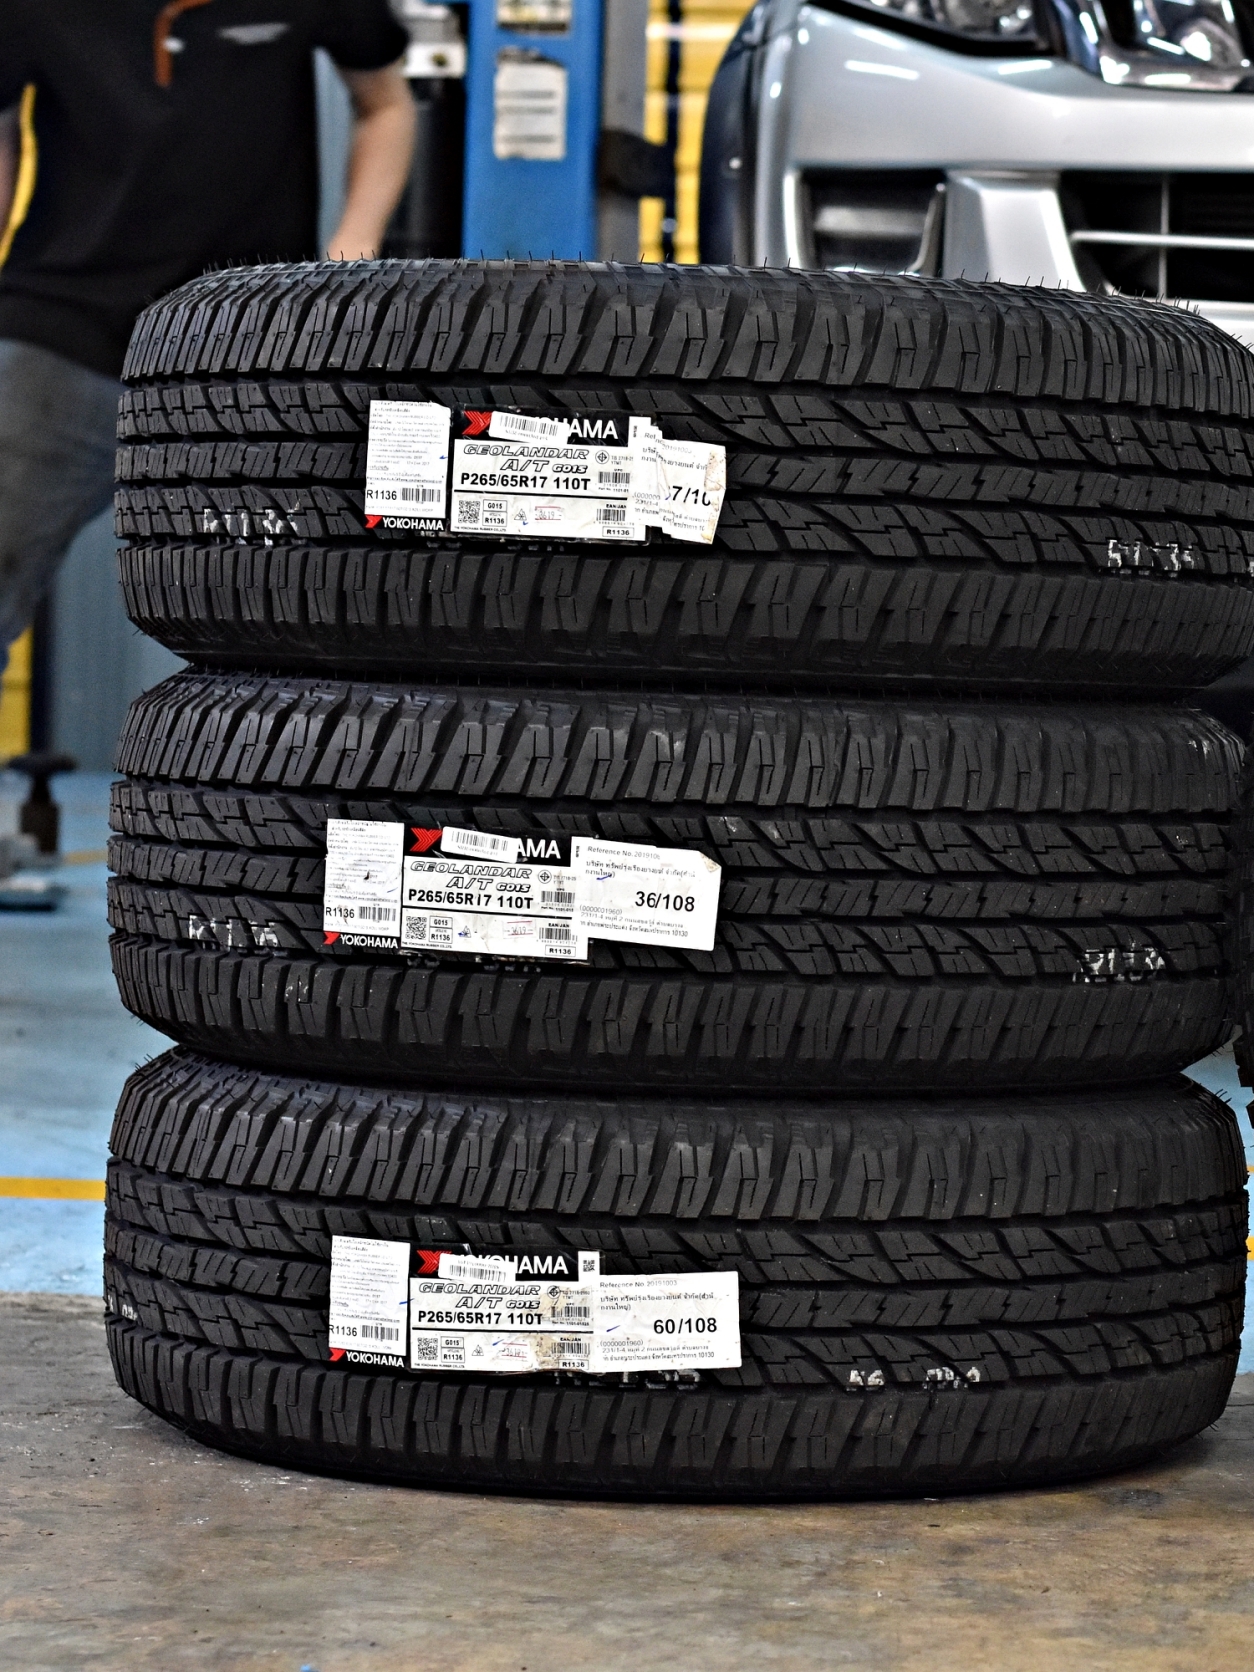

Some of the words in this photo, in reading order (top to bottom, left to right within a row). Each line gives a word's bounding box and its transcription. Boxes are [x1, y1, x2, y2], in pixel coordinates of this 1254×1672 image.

[463, 444, 589, 460] GEOLANDAR
[500, 459, 550, 471] A/T
[552, 464, 588, 474] G015
[461, 473, 548, 488] P265/65R17
[553, 477, 591, 491] 110T
[367, 490, 397, 500] R1136
[383, 517, 444, 531] YOKOHAMA
[485, 517, 505, 525] R1136
[587, 845, 621, 856] Reference
[410, 860, 532, 879] GEOLANDAR
[446, 876, 493, 890] A/T
[496, 882, 531, 892] G015
[408, 890, 493, 907] P265/65R17
[497, 896, 534, 909] 110T
[635, 891, 696, 912] 36/108
[326, 907, 355, 918] R1136
[434, 918, 448, 926] G015
[431, 933, 450, 941] R1136
[672, 930, 689, 938] 10130
[340, 934, 398, 949] YOKOHAMA
[419, 1282, 541, 1295] GEOLANDAR
[600, 1281, 633, 1289] Reference
[455, 1296, 503, 1309] A/T
[505, 1300, 541, 1309] G015
[418, 1310, 502, 1324] P265/65R17
[507, 1312, 543, 1325] 110T
[329, 1325, 358, 1337] R1136
[653, 1317, 718, 1335] 60/108
[346, 1350, 405, 1368] YOKOHAMA
[698, 1351, 715, 1359] 10130
